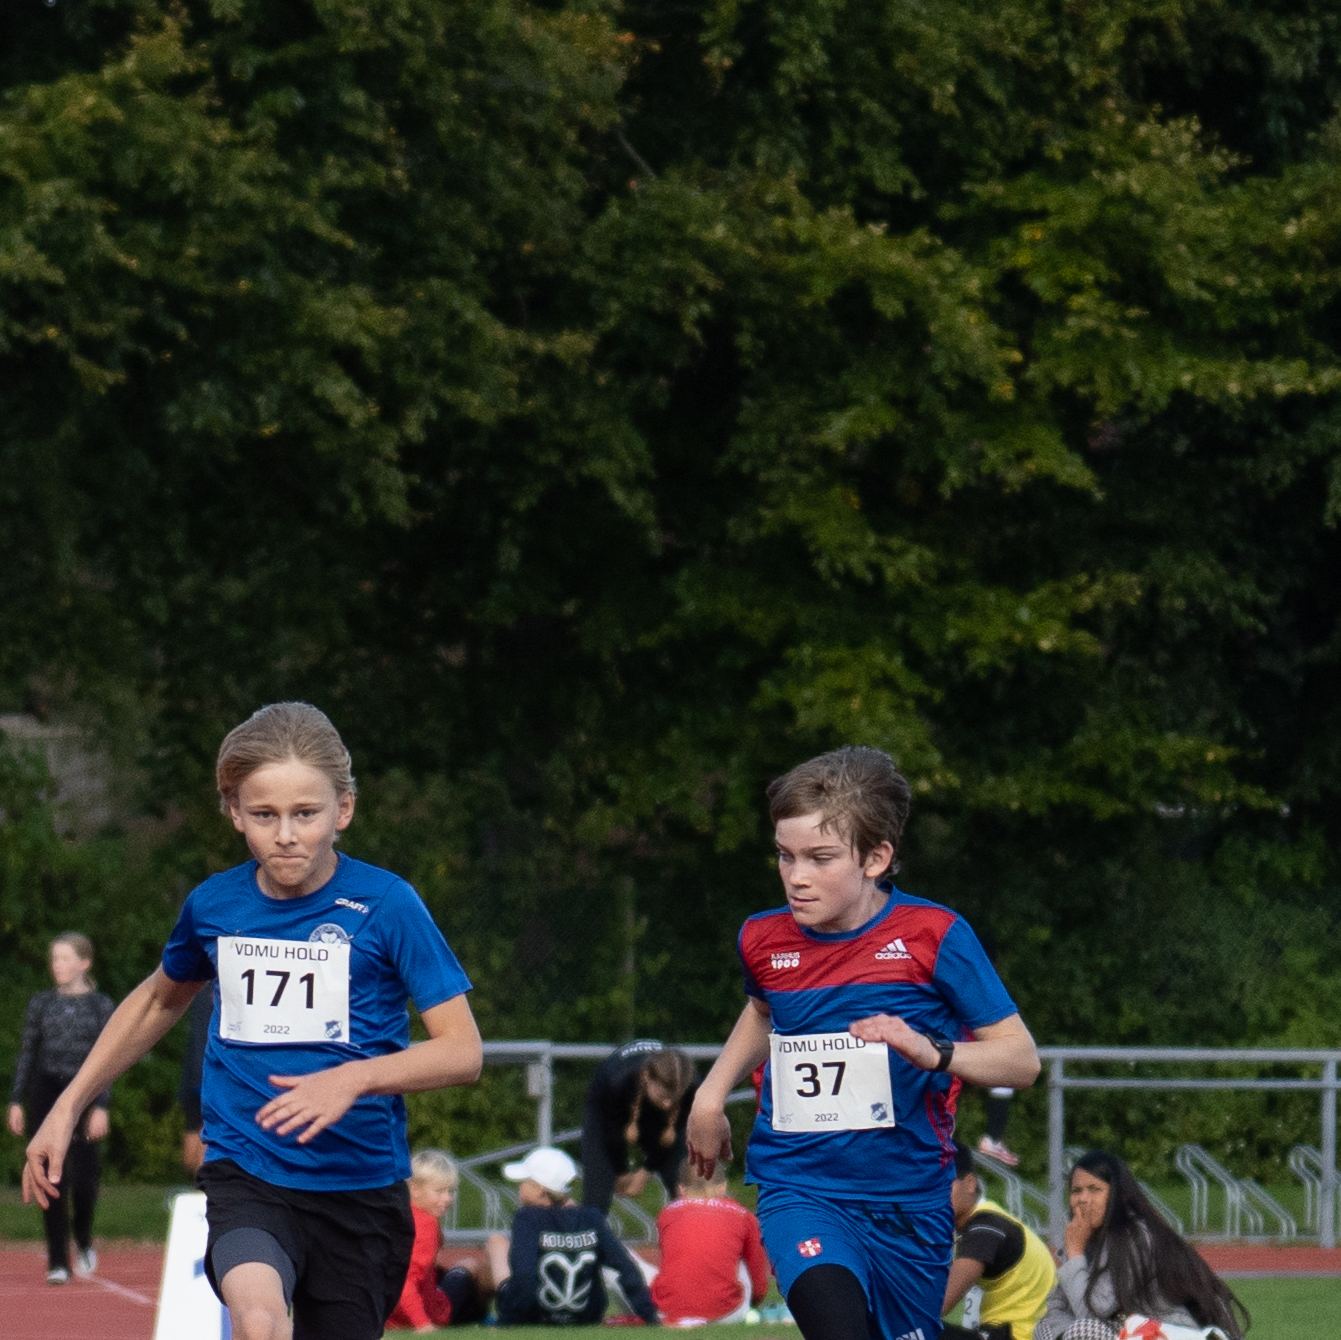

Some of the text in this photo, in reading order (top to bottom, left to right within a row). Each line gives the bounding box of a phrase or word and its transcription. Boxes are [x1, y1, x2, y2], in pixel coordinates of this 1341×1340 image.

[234, 943, 329, 962] VDMU HOLD
[770, 958, 800, 970] 1900
[241, 968, 315, 1010] 171
[263, 1024, 290, 1035] 2022
[822, 1037, 866, 1051] HOLD
[794, 1061, 846, 1098] 37
[814, 1112, 839, 1123] 2022
